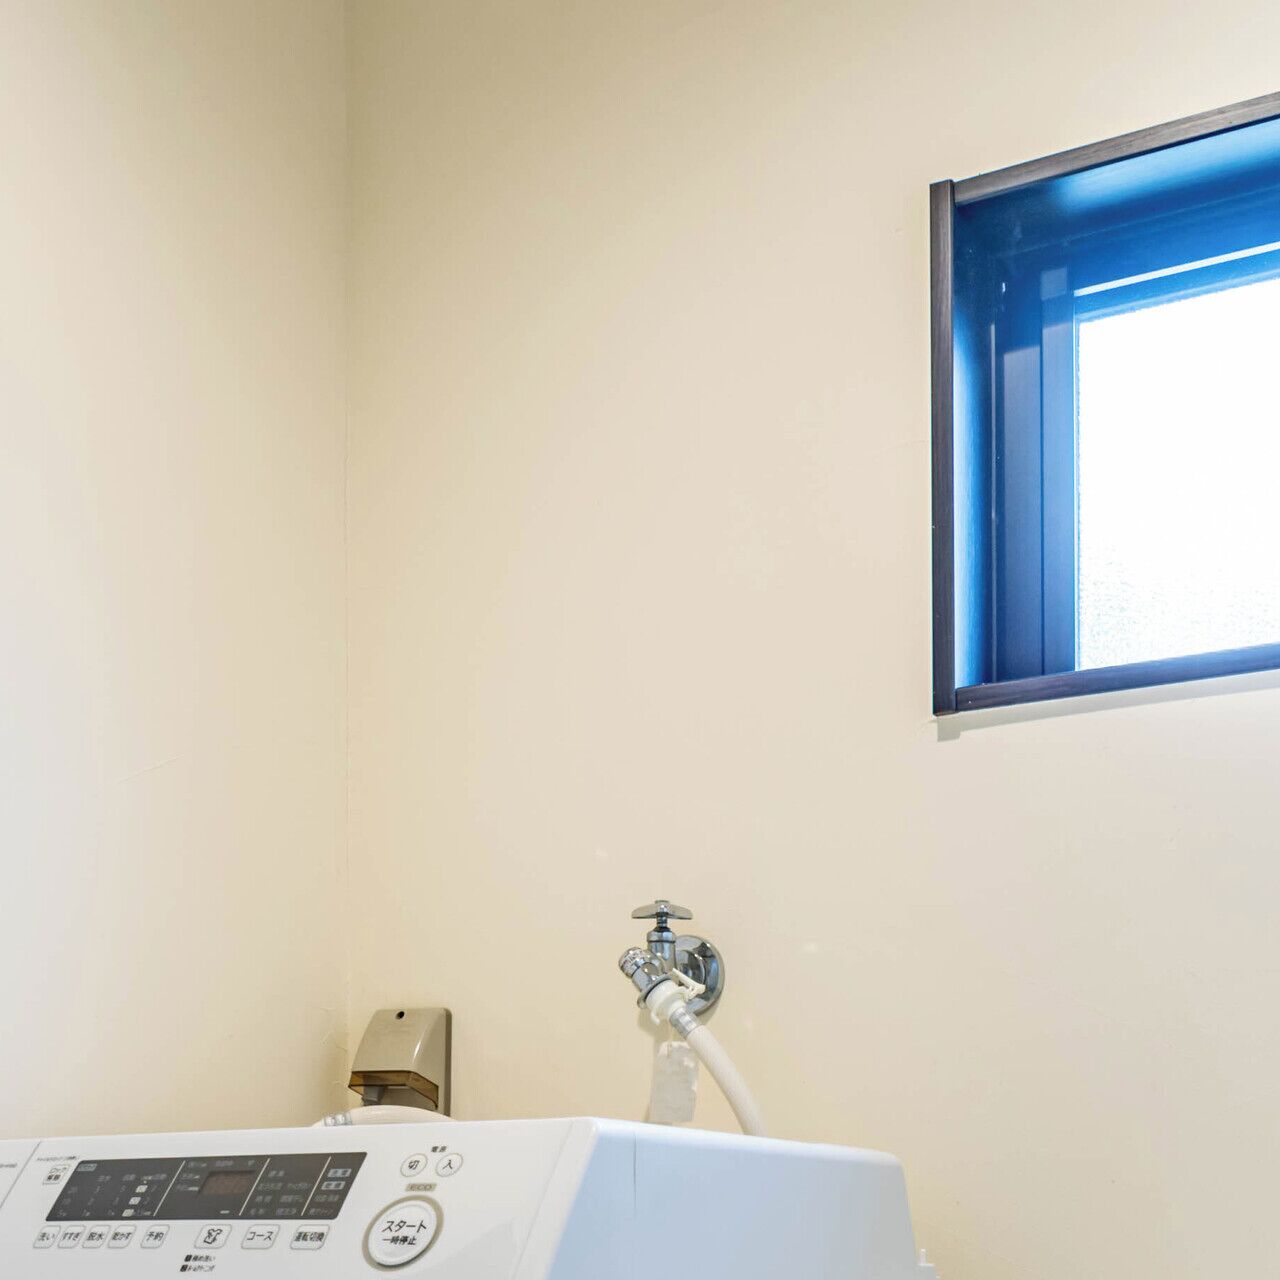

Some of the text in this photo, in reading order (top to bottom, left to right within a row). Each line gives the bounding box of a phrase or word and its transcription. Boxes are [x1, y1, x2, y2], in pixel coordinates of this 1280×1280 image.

[442, 1159, 454, 1170] 入
[381, 1219, 427, 1233] スタート
[37, 1231, 55, 1241] 洗い
[86, 1231, 104, 1241] 脱水
[146, 1231, 165, 1241] 予約
[247, 1231, 274, 1241] コース
[382, 1235, 418, 1246] 一時停止
